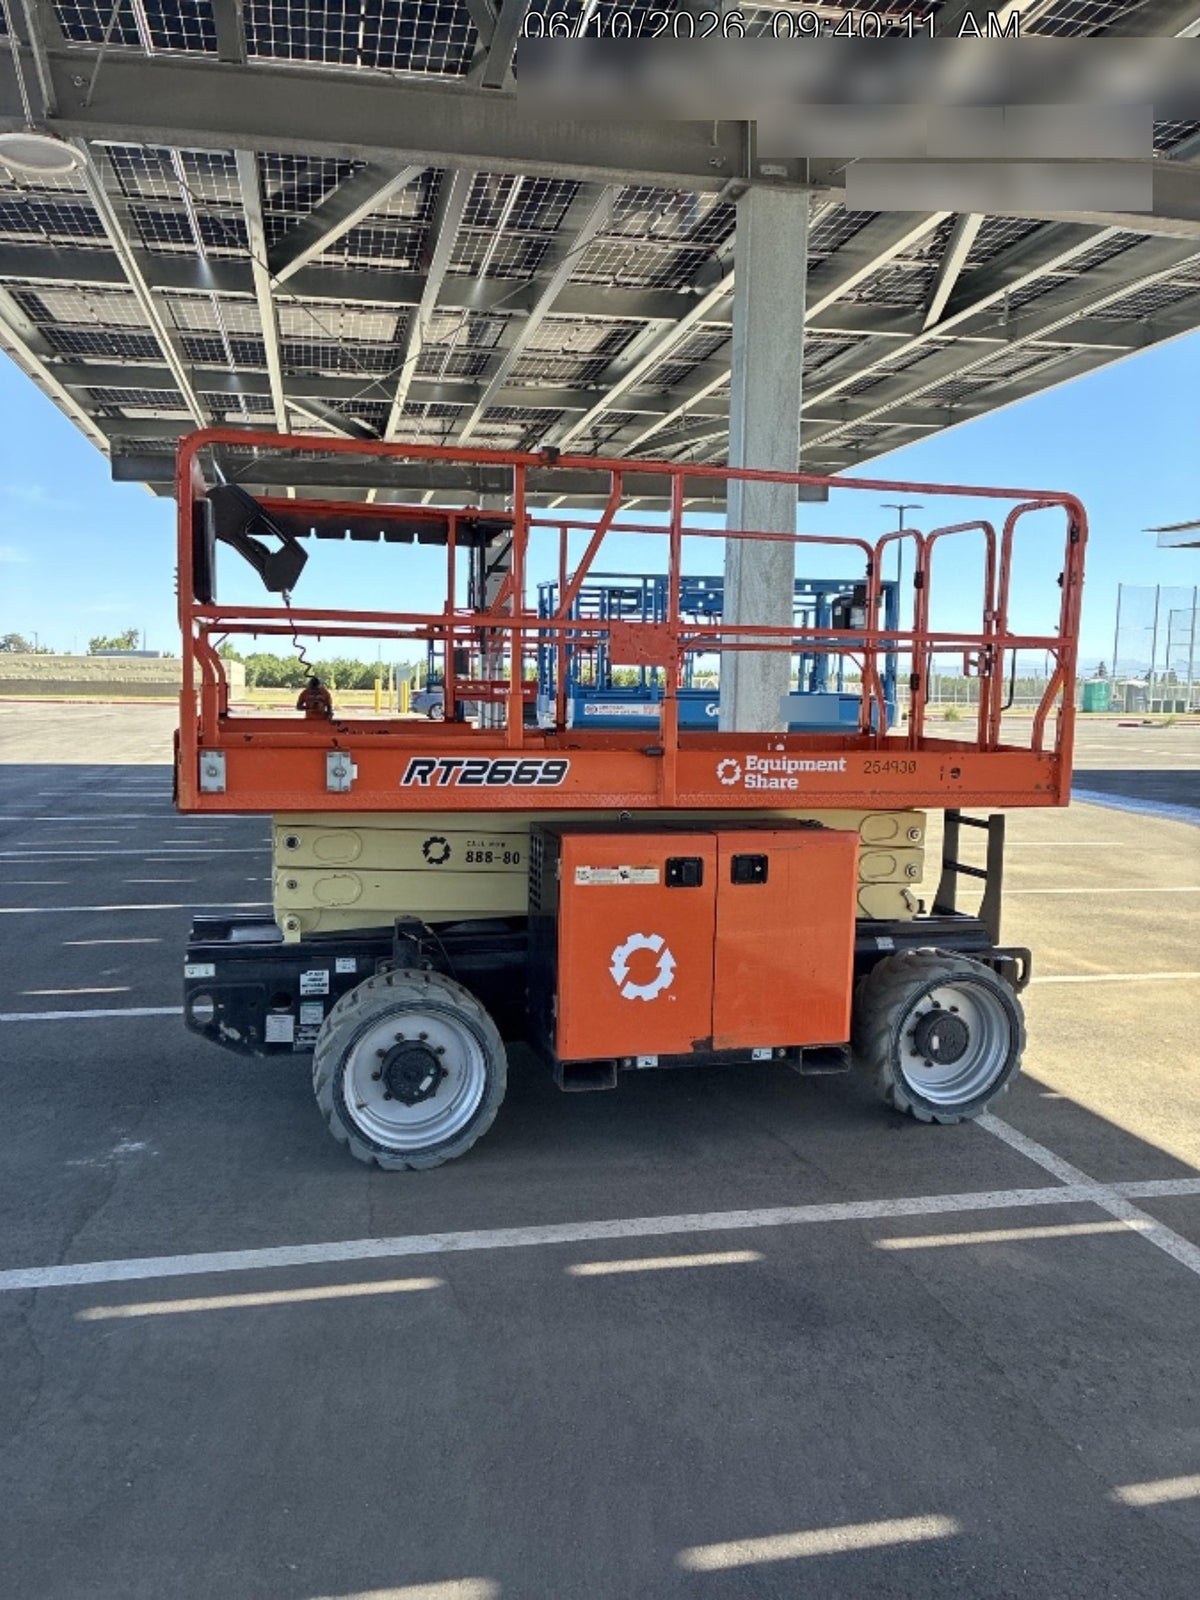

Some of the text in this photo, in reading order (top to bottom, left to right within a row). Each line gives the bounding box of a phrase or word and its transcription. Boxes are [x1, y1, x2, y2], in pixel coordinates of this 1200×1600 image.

[400, 757, 570, 787] RT2669
[745, 755, 847, 774] Equipment
[863, 760, 917, 774] 254930
[744, 774, 799, 790] Share
